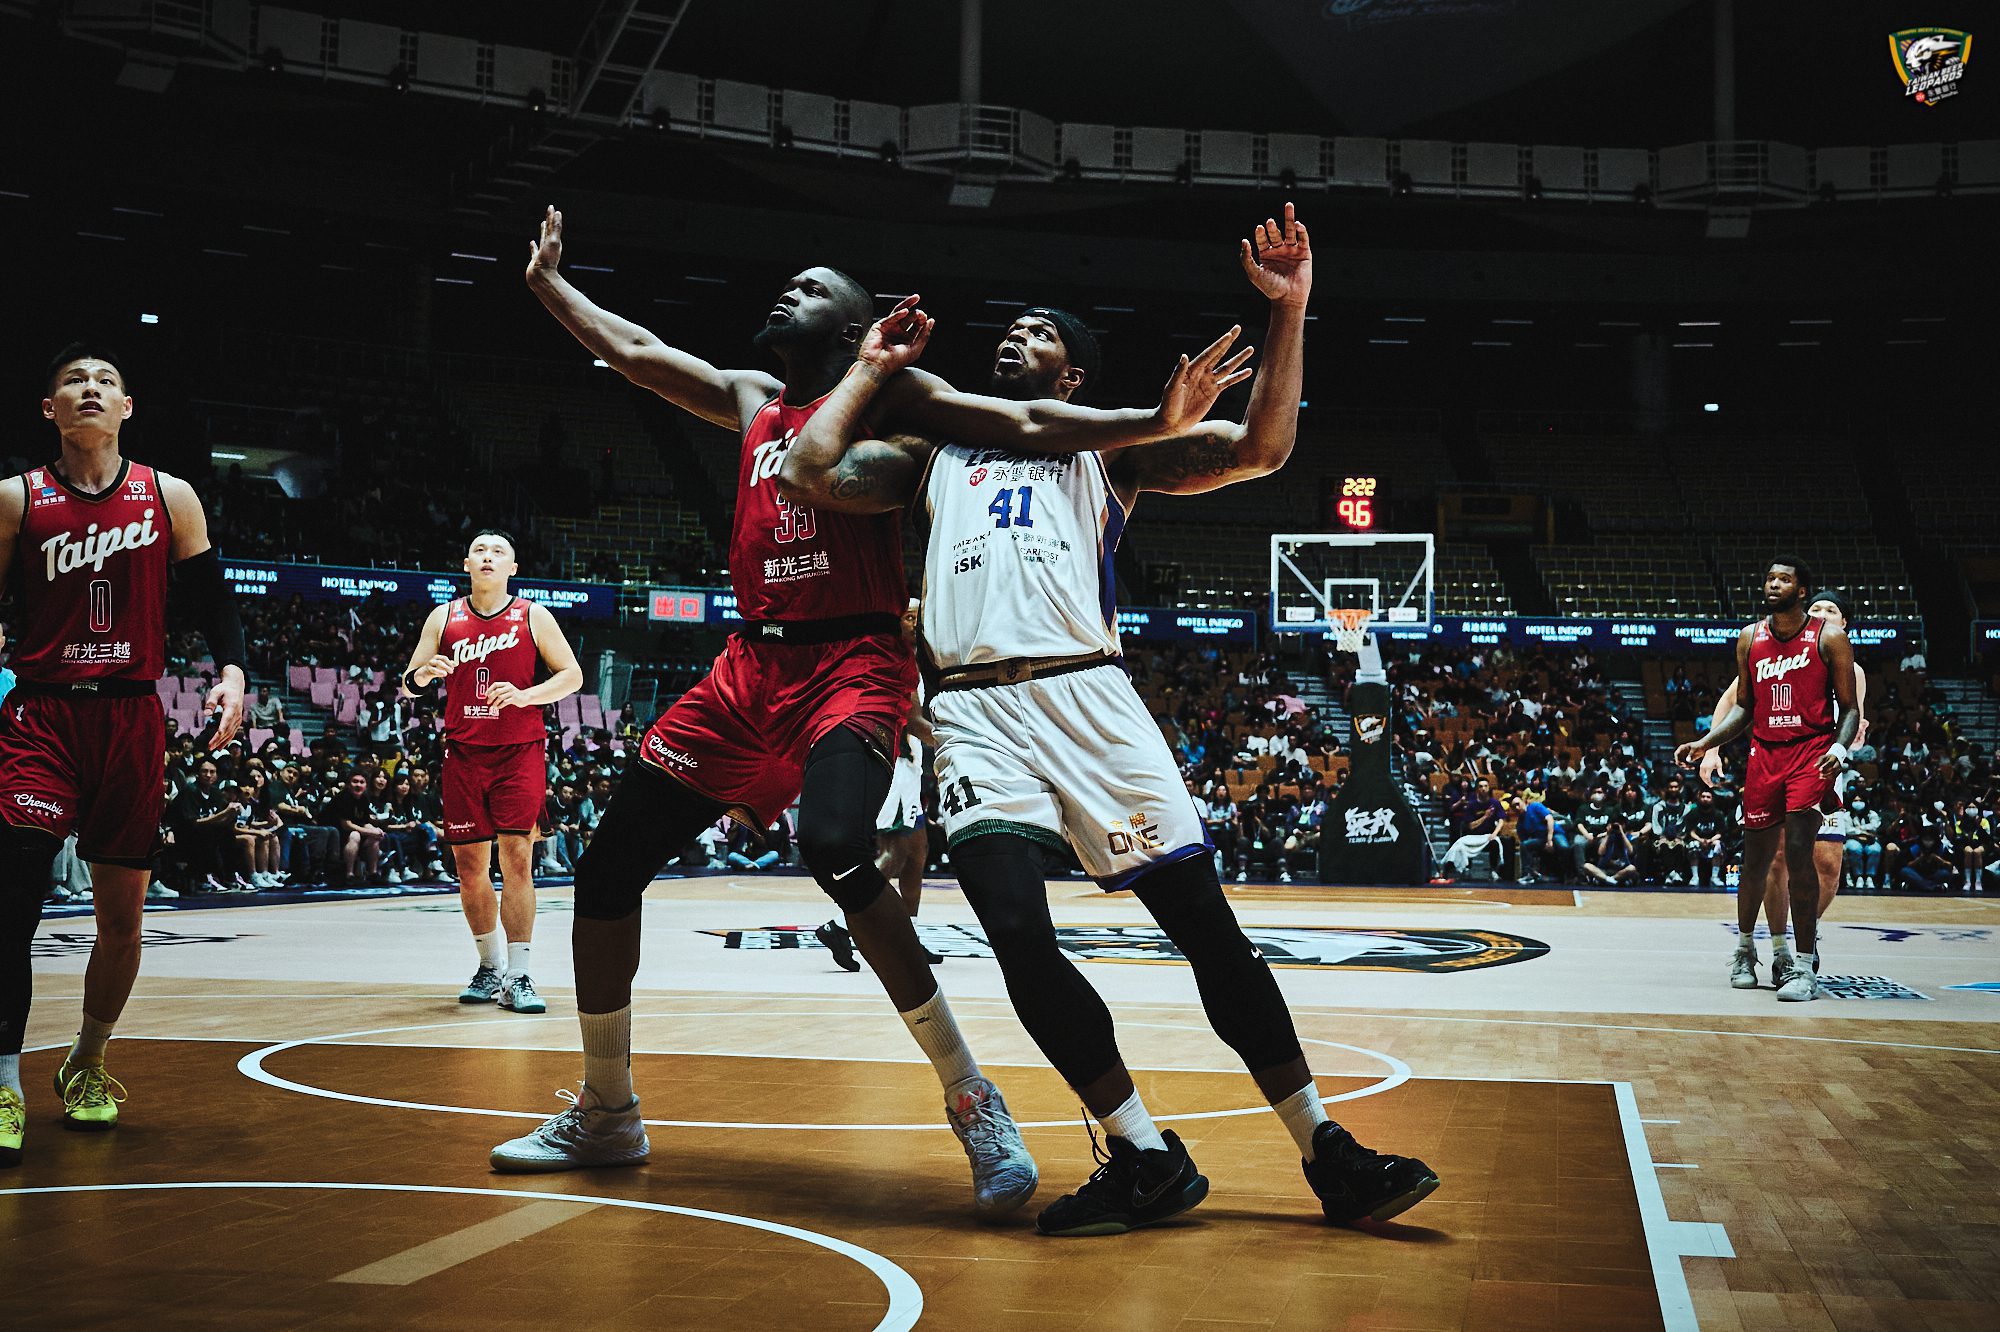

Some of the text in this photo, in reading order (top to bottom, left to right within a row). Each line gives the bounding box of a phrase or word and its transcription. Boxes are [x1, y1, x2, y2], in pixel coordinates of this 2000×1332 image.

[750, 428, 797, 487] Tai
[988, 486, 1034, 528] 41
[41, 508, 159, 581] Taipei
[764, 550, 830, 578] 新光三越
[322, 576, 357, 589] HOTEL
[518, 588, 588, 603] HOTEL INDIGO
[90, 580, 112, 632] 0
[655, 596, 700, 617] 出口
[1177, 617, 1244, 629] HOTEL INDIGO
[1526, 626, 1592, 637] HOTEL INDIGO
[1675, 628, 1741, 638] HOTEL INDIGO
[1861, 629, 1896, 638] INDIGO
[62, 641, 131, 659] 新光三越
[452, 625, 520, 667] Taipei
[1756, 646, 1810, 682] Taipei
[476, 667, 490, 700] 8
[1771, 684, 1792, 711] 10
[650, 734, 698, 768] Cherubic
[14, 794, 64, 815] Cherubic
[944, 776, 982, 817] 41
[1108, 824, 1165, 855] ONE
